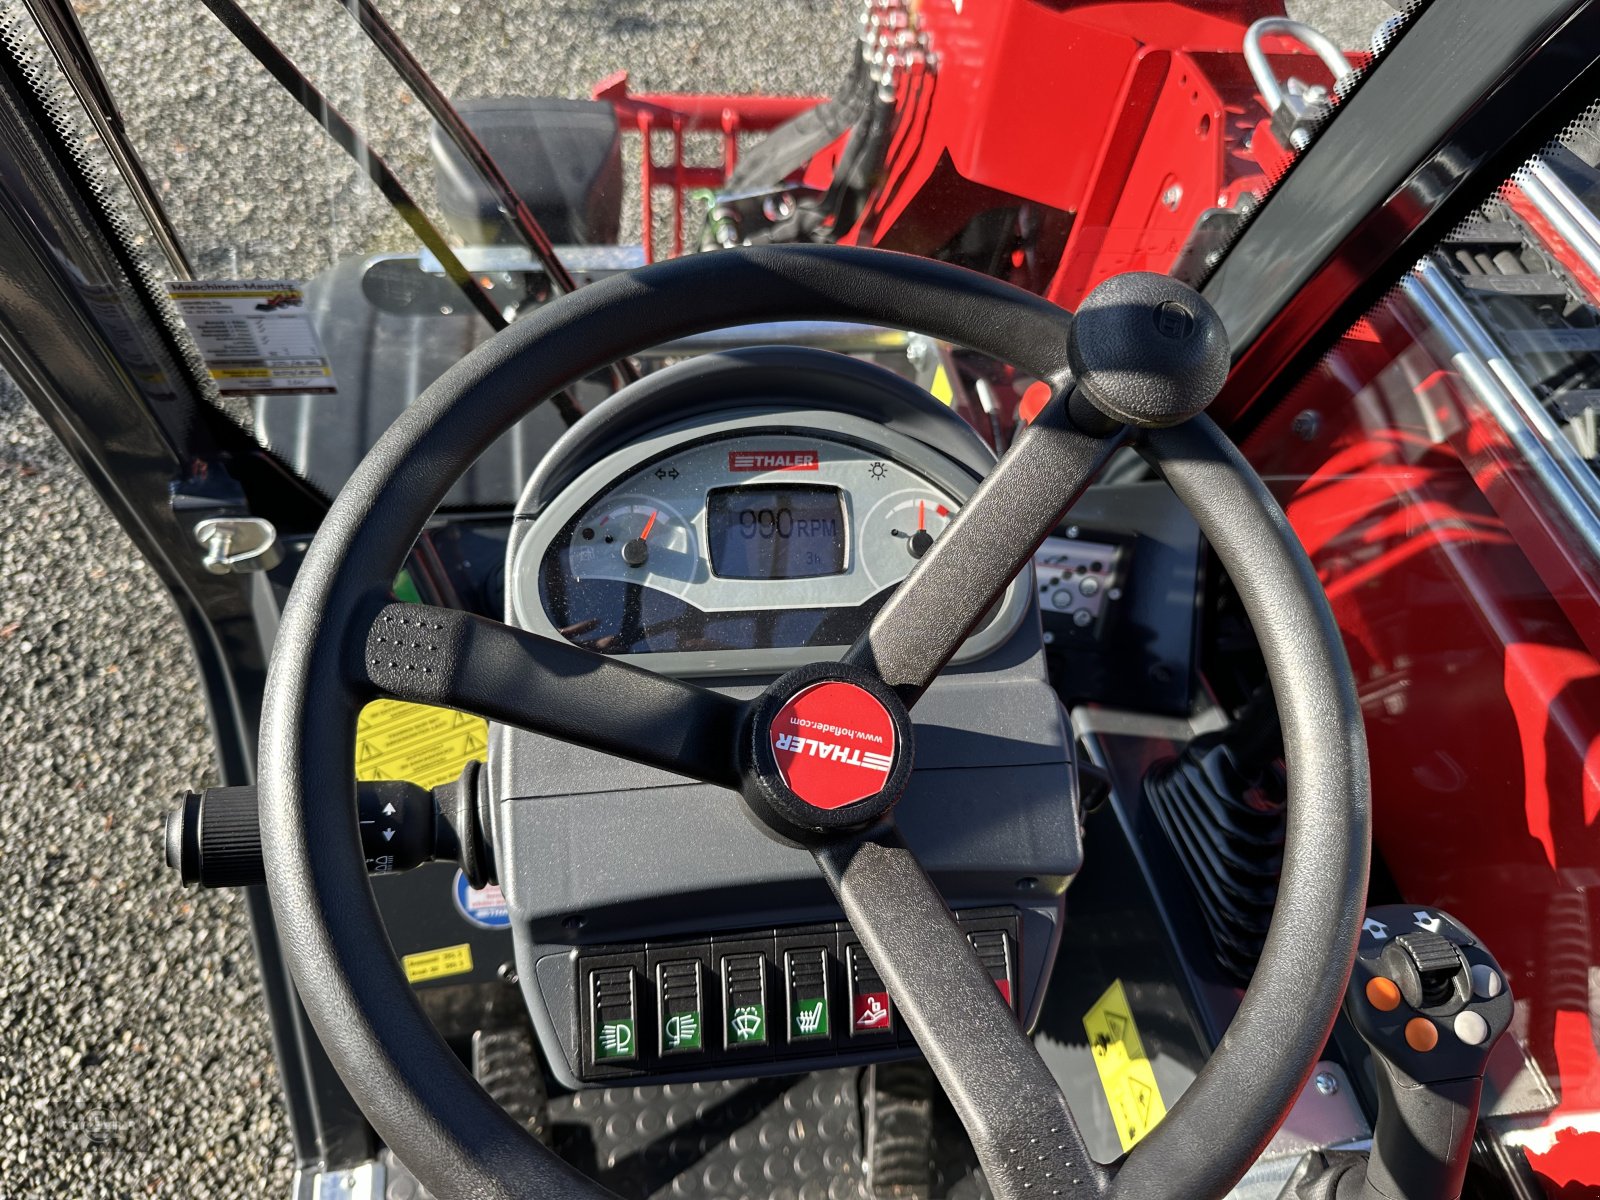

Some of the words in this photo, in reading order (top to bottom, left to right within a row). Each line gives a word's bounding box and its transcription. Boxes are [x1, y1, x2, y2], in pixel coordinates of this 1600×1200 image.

[171, 283, 295, 291] Maschinen-Mauritz
[754, 455, 814, 467] THALER
[740, 508, 793, 539] 990
[797, 518, 837, 537] RPM
[790, 717, 883, 743] www.hoflader.com
[775, 732, 862, 767] THALER
